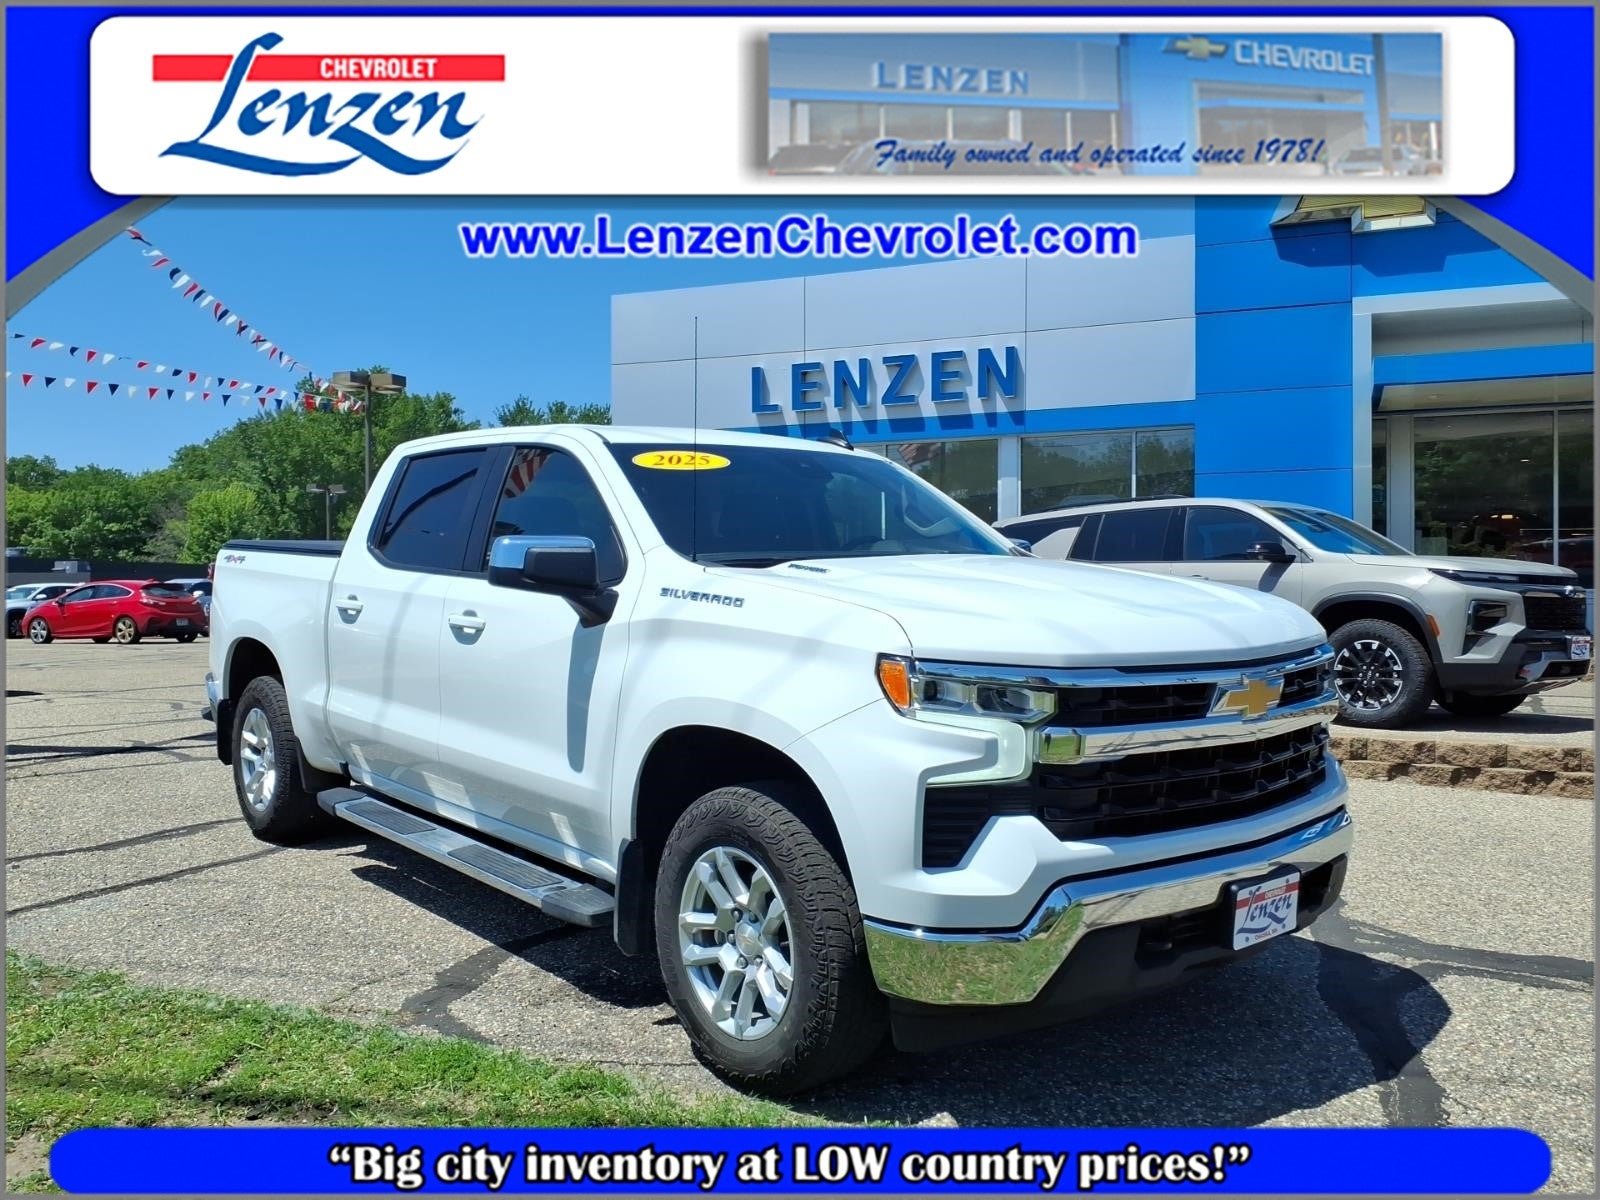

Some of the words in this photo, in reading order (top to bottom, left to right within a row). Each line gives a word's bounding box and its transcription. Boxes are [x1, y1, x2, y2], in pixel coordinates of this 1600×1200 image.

[750, 346, 1018, 414] LENZEN
[651, 455, 712, 466] 2025
[660, 587, 744, 608] SILVERADO
[1236, 886, 1292, 935] Lenzen
